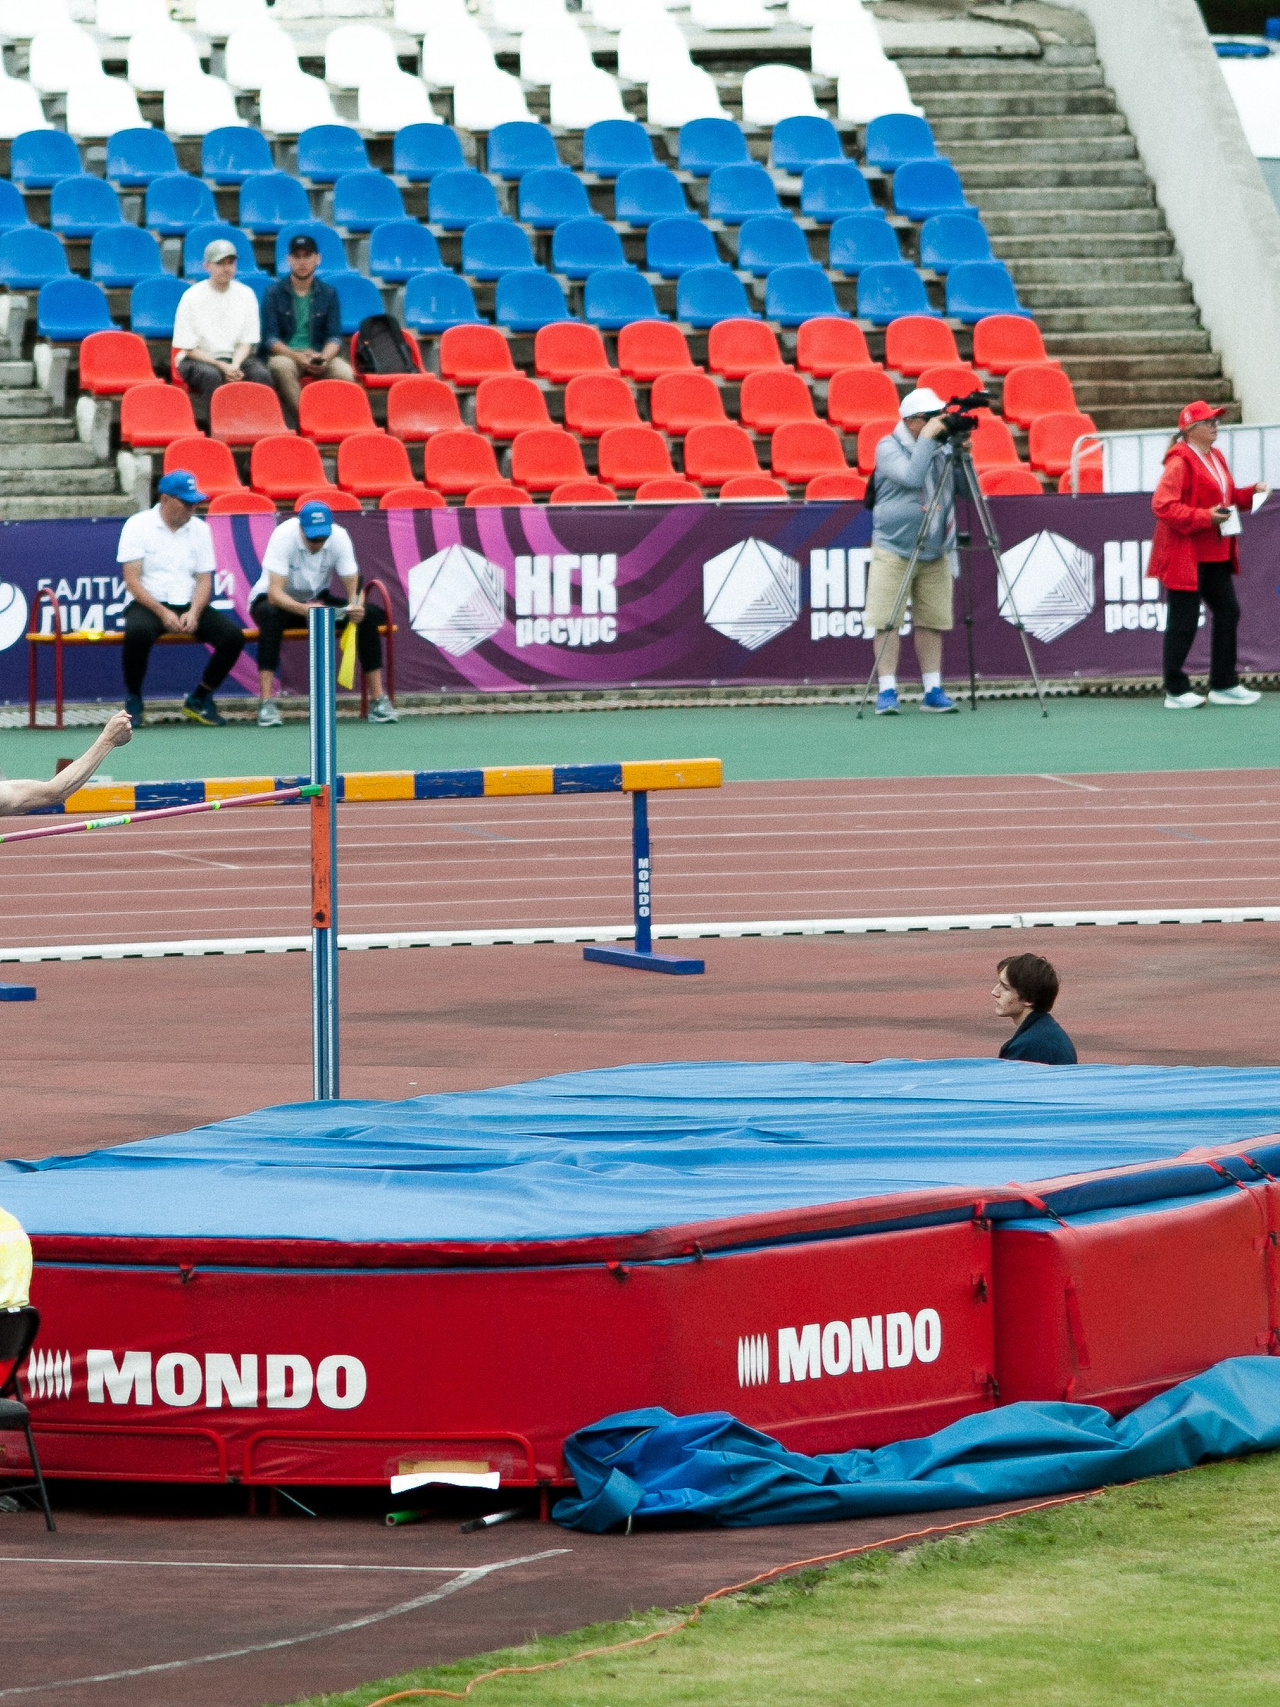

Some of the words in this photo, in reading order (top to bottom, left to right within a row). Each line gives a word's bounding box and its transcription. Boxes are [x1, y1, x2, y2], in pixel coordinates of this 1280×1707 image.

[515, 553, 617, 615] НГК
[810, 548, 912, 608] НГ
[516, 616, 617, 647] ресурс
[638, 858, 650, 917] MONDO
[778, 1308, 941, 1384] MONDO
[87, 1349, 367, 1409] MONDO
